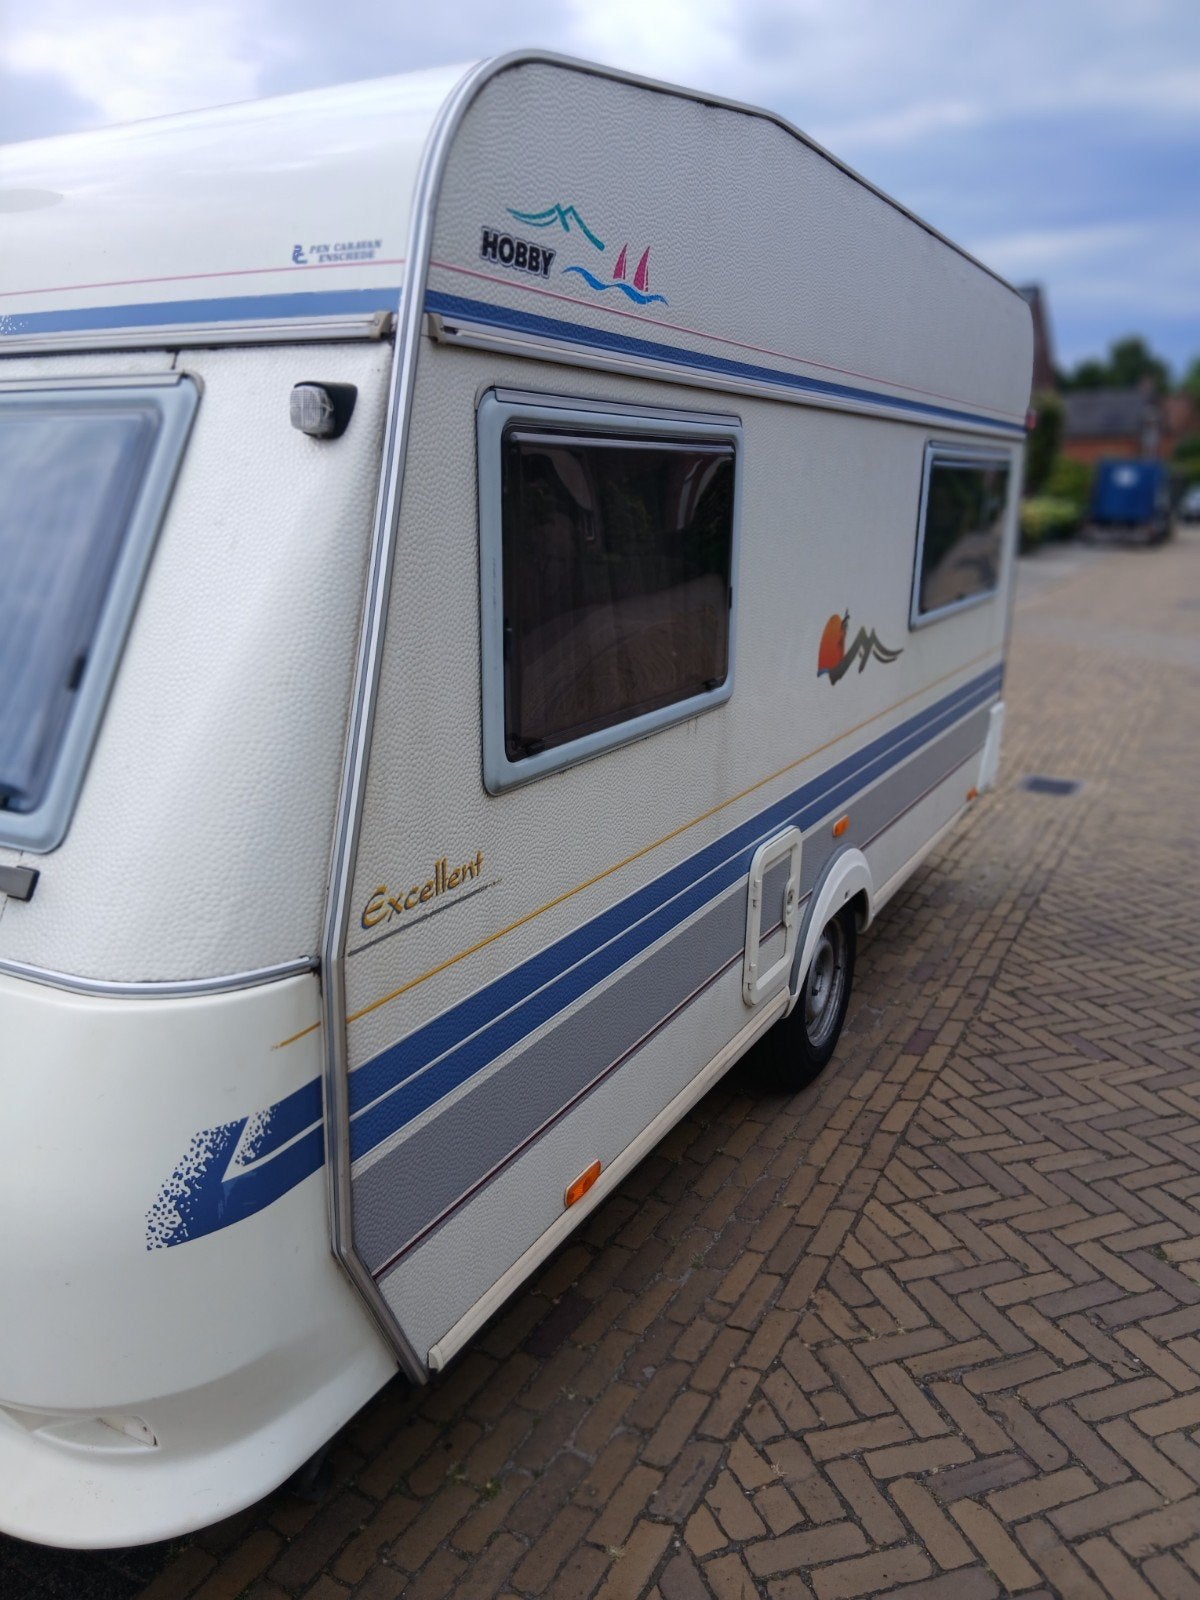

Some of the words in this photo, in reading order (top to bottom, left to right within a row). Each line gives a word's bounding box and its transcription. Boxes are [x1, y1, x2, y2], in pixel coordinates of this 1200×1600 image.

[309, 245, 331, 255] PEN
[333, 239, 382, 252] CARAVAN
[318, 250, 375, 263] ENSCHEDE
[481, 226, 556, 279] HOBBY
[361, 849, 485, 930] Excellent
